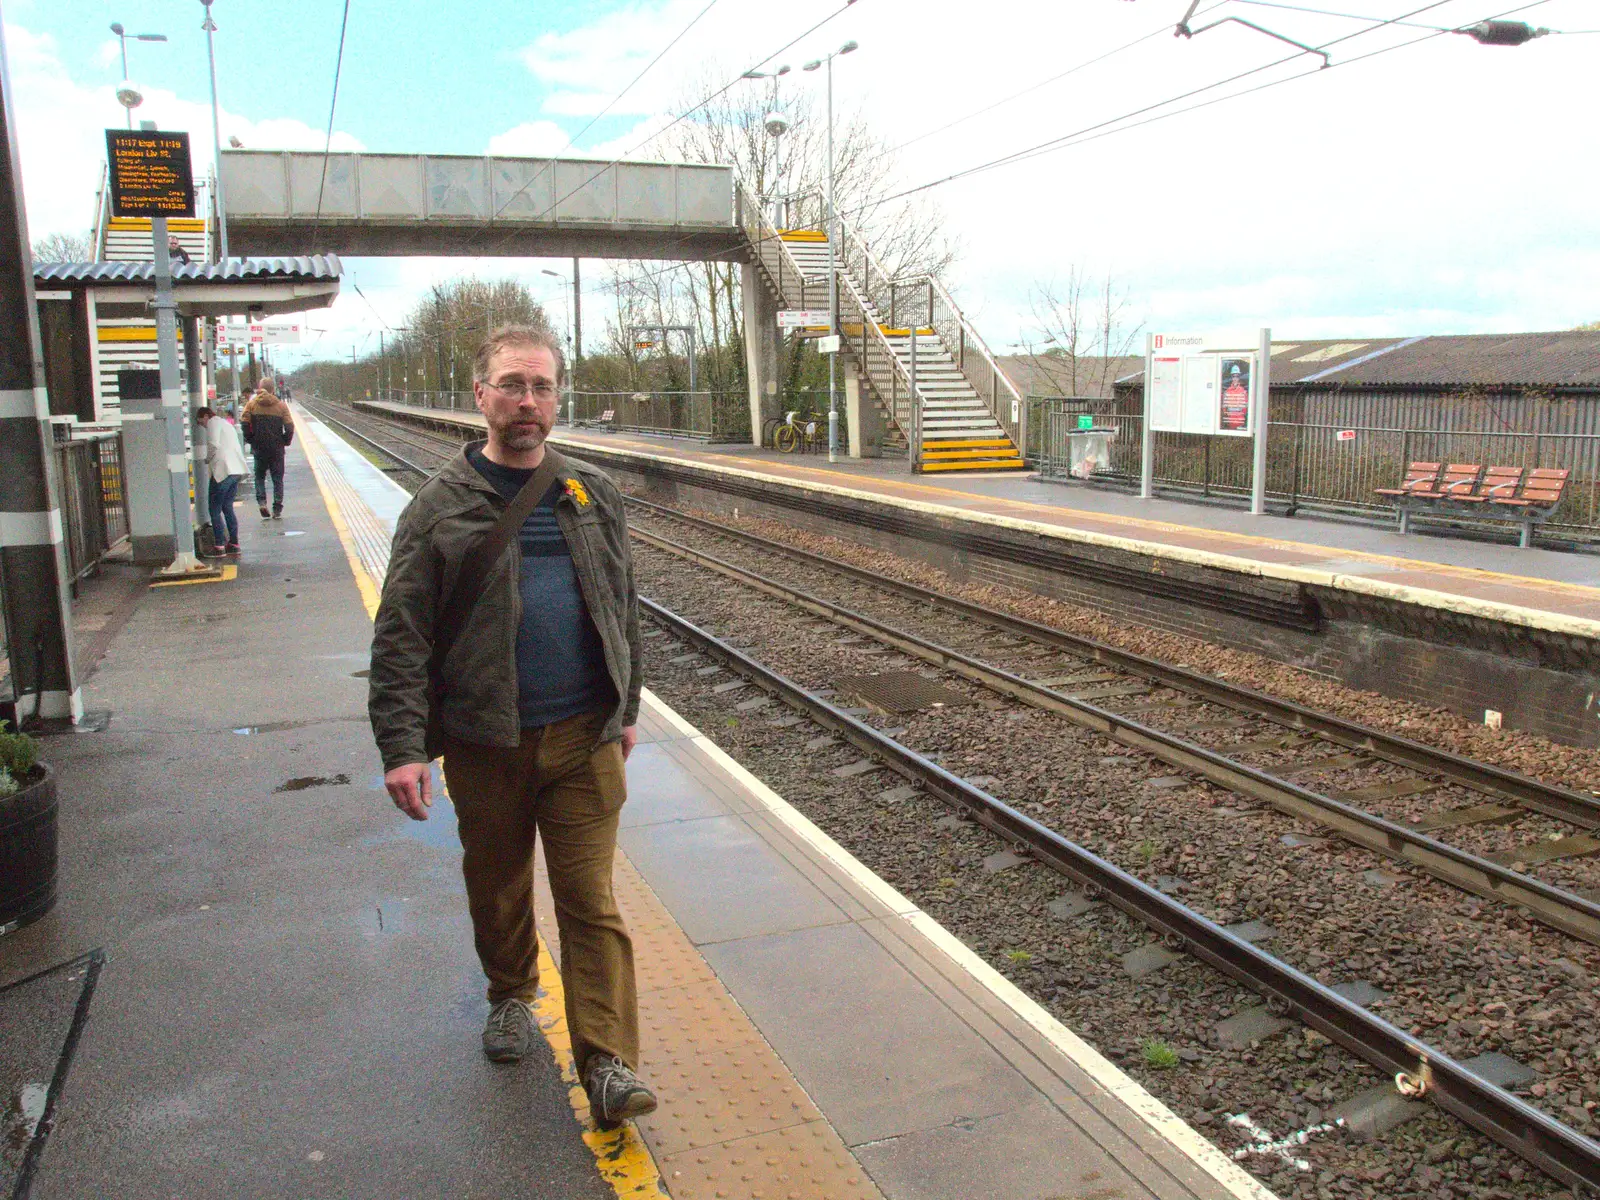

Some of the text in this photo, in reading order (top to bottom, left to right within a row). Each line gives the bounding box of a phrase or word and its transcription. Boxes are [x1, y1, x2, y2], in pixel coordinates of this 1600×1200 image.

[116, 139, 137, 147] 11:17
[116, 149, 144, 157] London
[1166, 336, 1203, 346] Information
